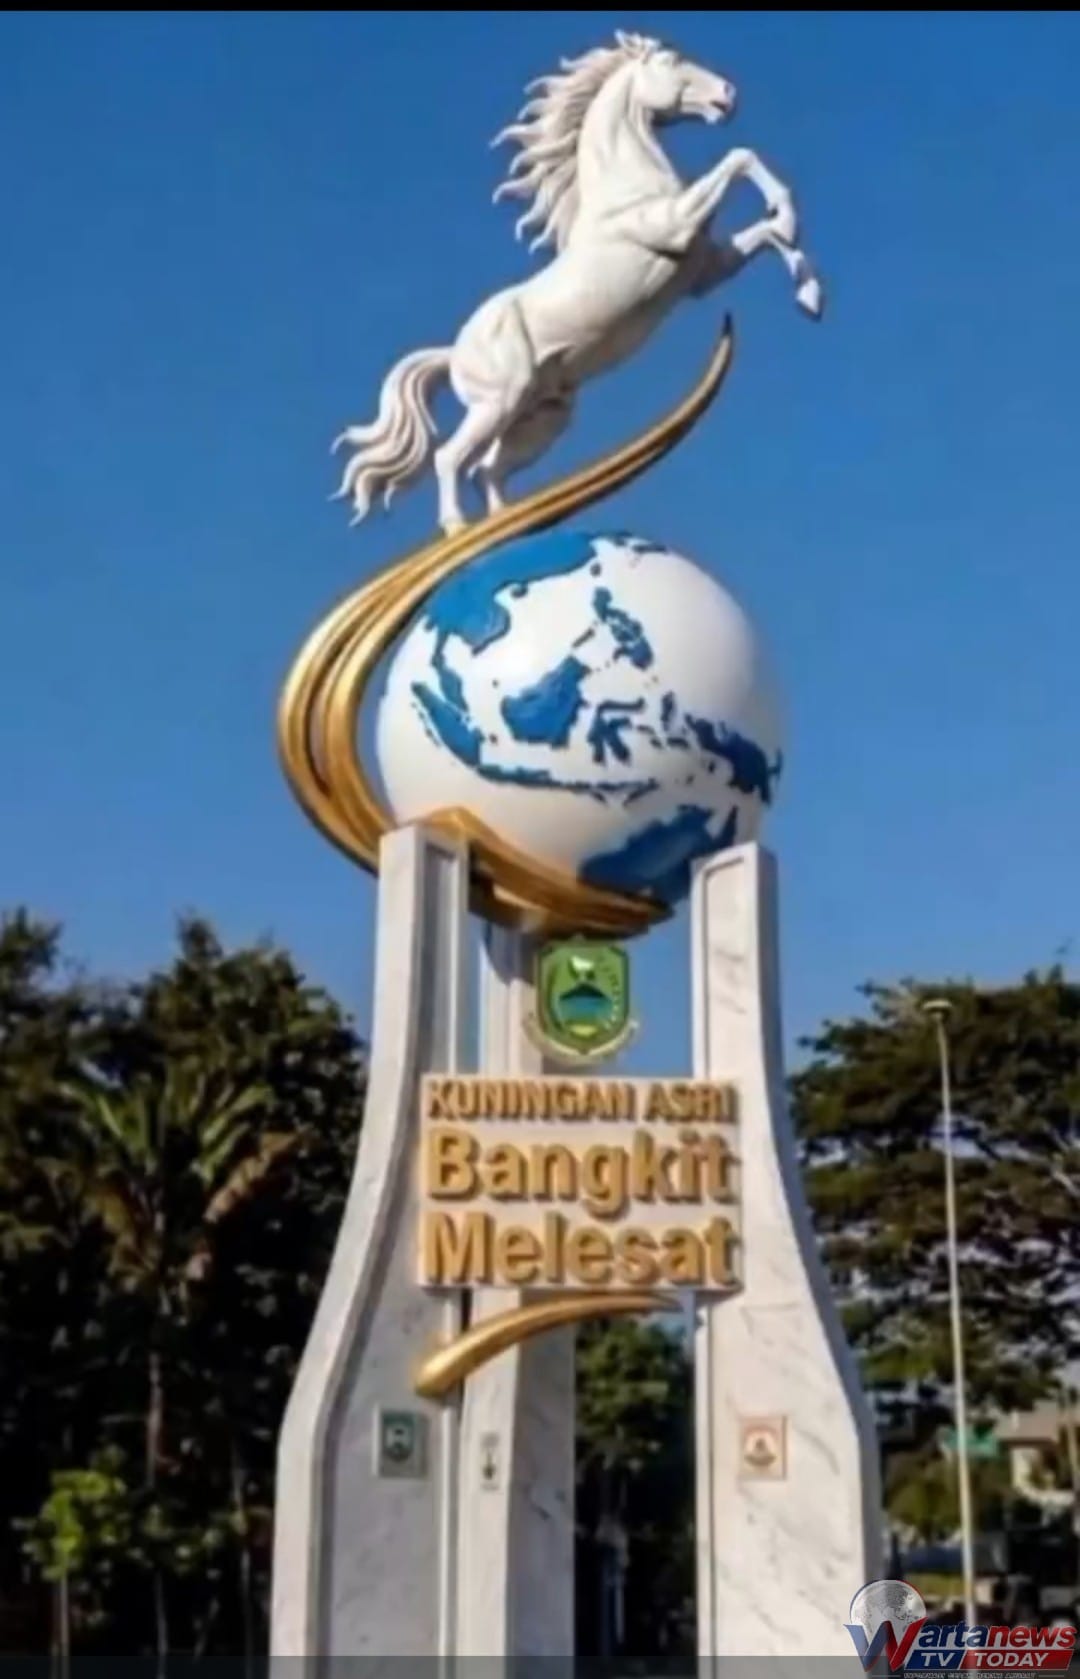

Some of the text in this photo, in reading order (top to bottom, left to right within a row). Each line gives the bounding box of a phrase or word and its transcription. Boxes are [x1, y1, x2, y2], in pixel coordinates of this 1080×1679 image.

[428, 1081, 635, 1120] KUNINGAN
[426, 1127, 741, 1221] Bangkit
[423, 1211, 740, 1286] Melesat
